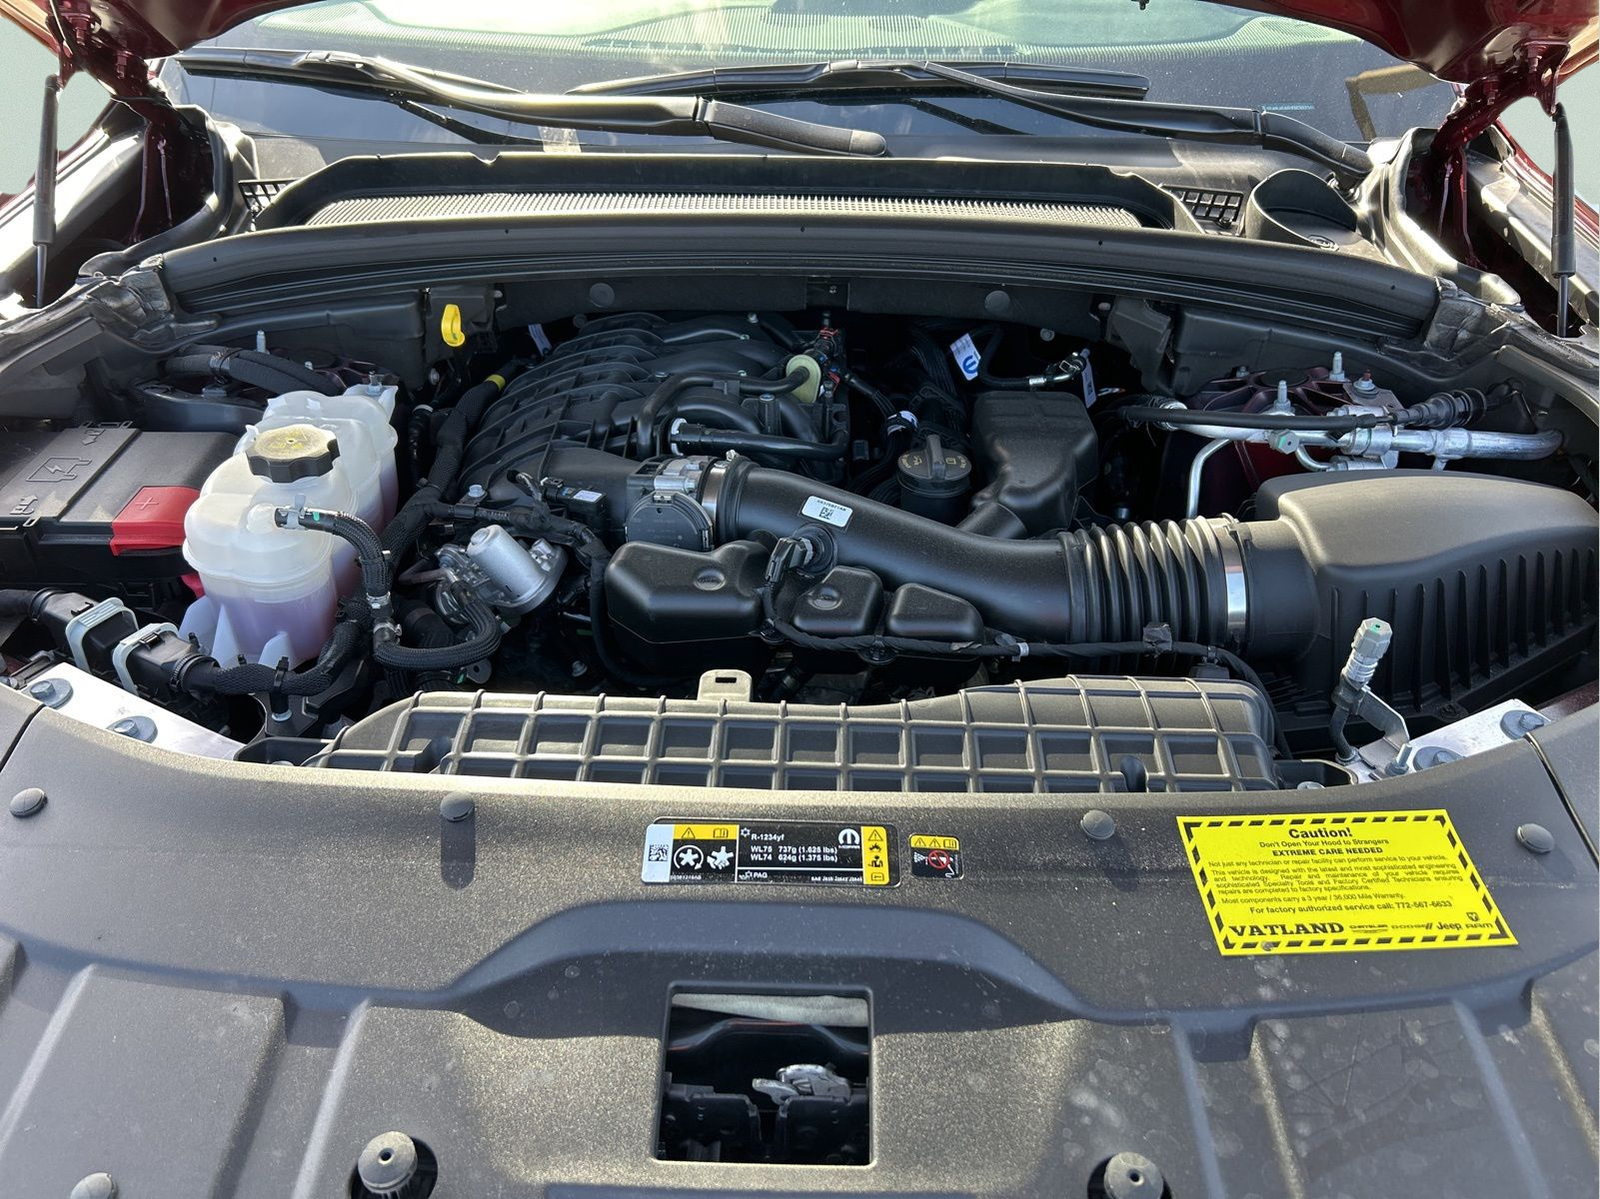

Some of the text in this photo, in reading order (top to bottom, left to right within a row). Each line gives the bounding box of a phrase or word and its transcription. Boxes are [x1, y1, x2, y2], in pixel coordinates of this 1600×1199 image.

[1288, 828, 1353, 838] Caution!
[750, 834, 785, 842] R-1234yf
[1352, 838, 1390, 846] Strangers
[778, 846, 797, 854] 737g
[822, 846, 838, 854] lbs)
[1272, 848, 1317, 856] EXTREME
[822, 854, 838, 862] lbs)
[1324, 884, 1372, 892] specifications.
[1266, 906, 1296, 914] factory
[1228, 922, 1344, 936] VATLAND
[1436, 922, 1462, 931] Jeep
